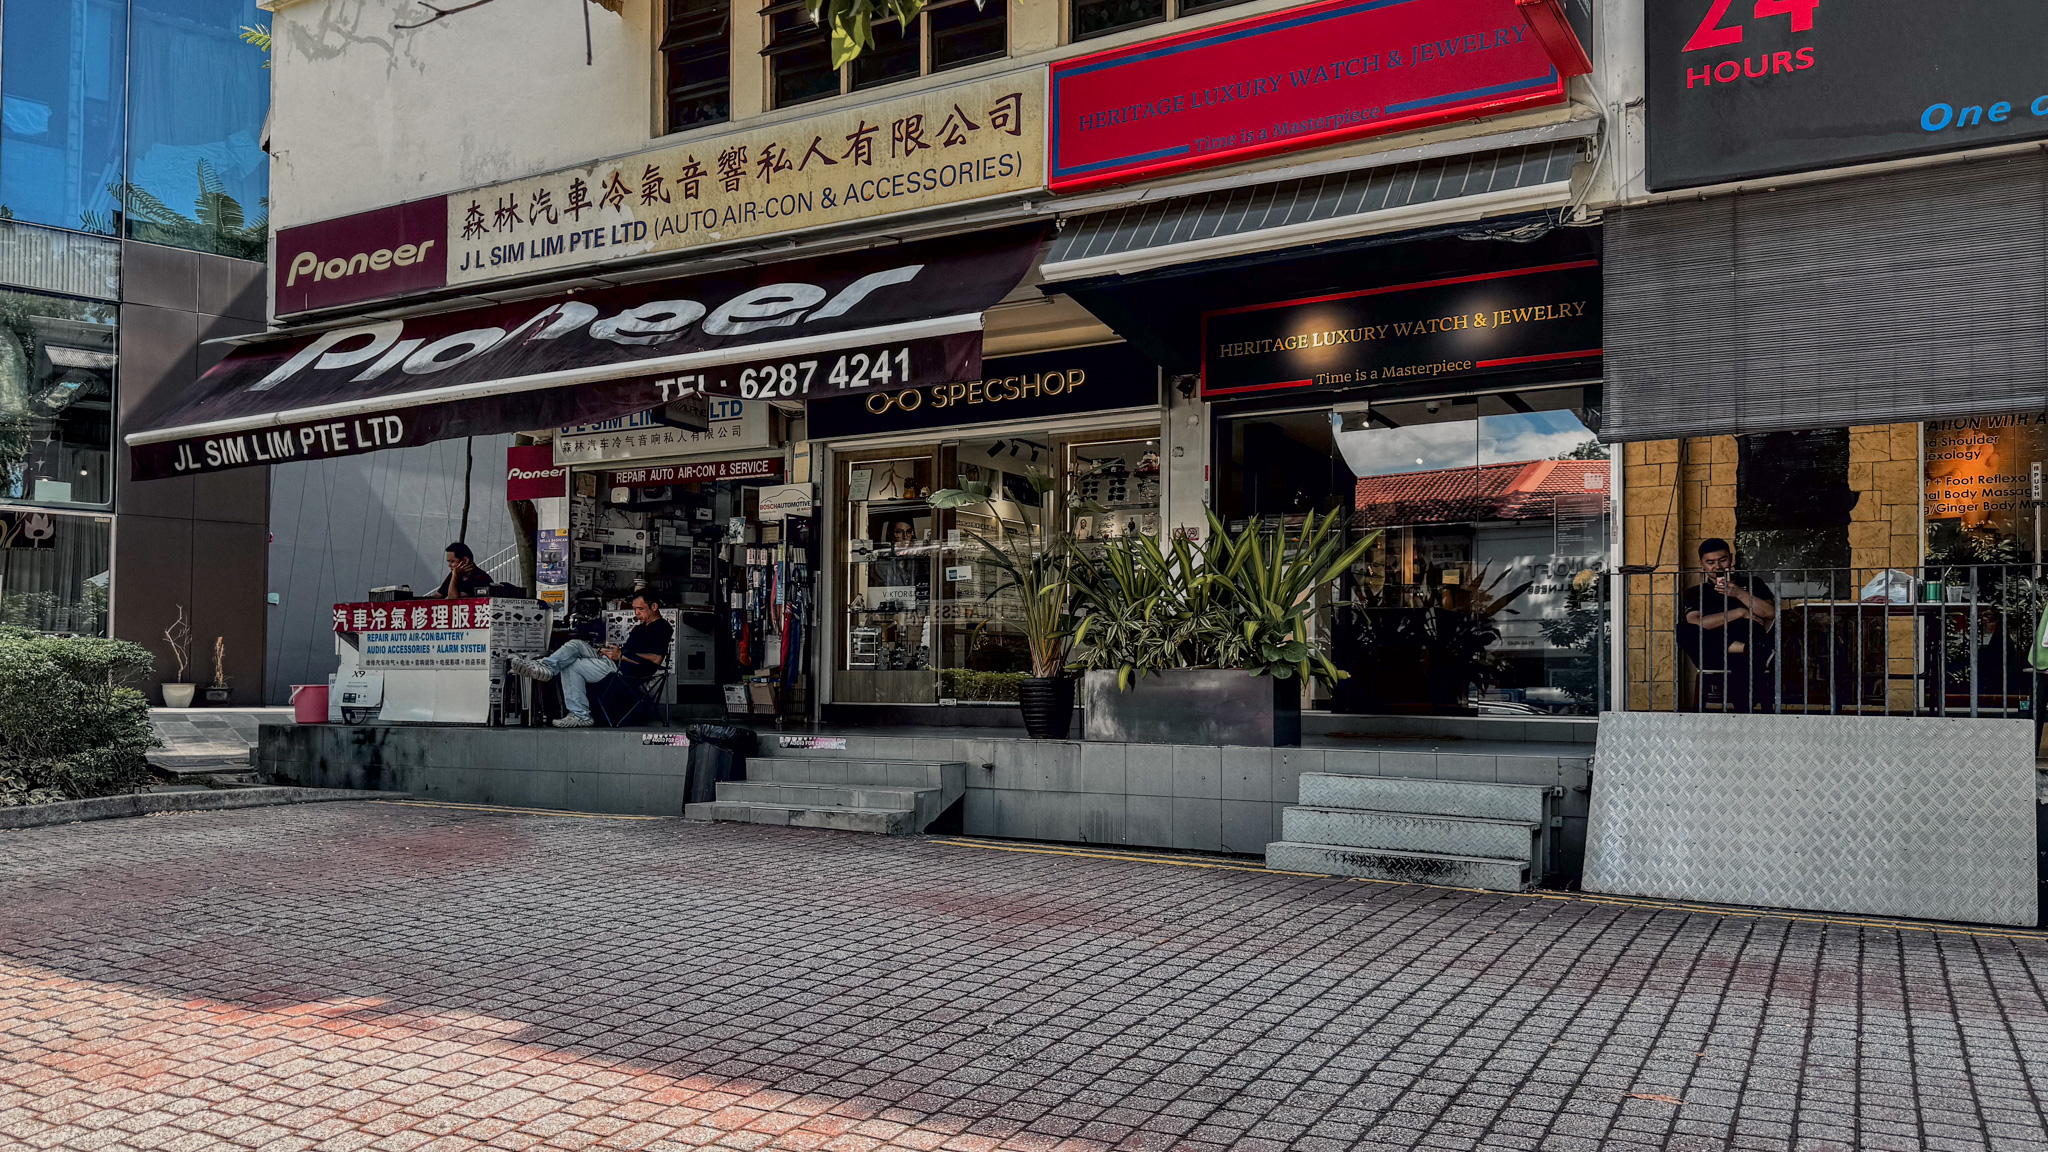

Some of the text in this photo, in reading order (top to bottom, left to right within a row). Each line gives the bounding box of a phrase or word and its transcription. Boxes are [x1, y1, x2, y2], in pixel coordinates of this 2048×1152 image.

[1079, 24, 1529, 132] HERITAGE LUXURY WATCH & JEWELRY
[1687, 47, 1816, 89] HOURS
[1194, 103, 1381, 153] Time is a Masterpiece
[1920, 101, 2012, 131] One
[460, 92, 1024, 241] 森林汽車冷氣音響私人有限公司
[460, 151, 1023, 272] J L SIM LIM PTE LTD (AUTO AIR-CON & ACCESSORIES)
[286, 240, 435, 288] Pioneer
[243, 264, 926, 392] Pioneer
[1219, 301, 1587, 358] HERITAGE LUXURY WATCH & JEWELRY
[739, 361, 819, 399] 6287
[828, 347, 911, 389] 4241
[1316, 359, 1472, 386] Time is a Masterpiece
[931, 369, 1087, 408] SPECSHOP
[709, 400, 744, 419] LTD
[205, 434, 250, 467] SIM
[252, 430, 293, 461] LIM
[300, 423, 349, 455] PTE
[355, 415, 405, 448] LTD
[1941, 434, 1999, 447] Shoulder
[508, 466, 566, 481] Pioneer
[615, 459, 769, 484] REPAIR AUTO AIR-CON & SERVICE
[1946, 475, 1974, 486] Foot
[1944, 489, 1977, 500] Body
[1983, 500, 2016, 512] Body
[332, 604, 491, 631] 汽車冷氣修理服務
[367, 632, 390, 642] REPAIR
[390, 632, 408, 642] AUTO
[367, 643, 486, 654] AUDIO ACCESSORIES ALARM SYSTEM
